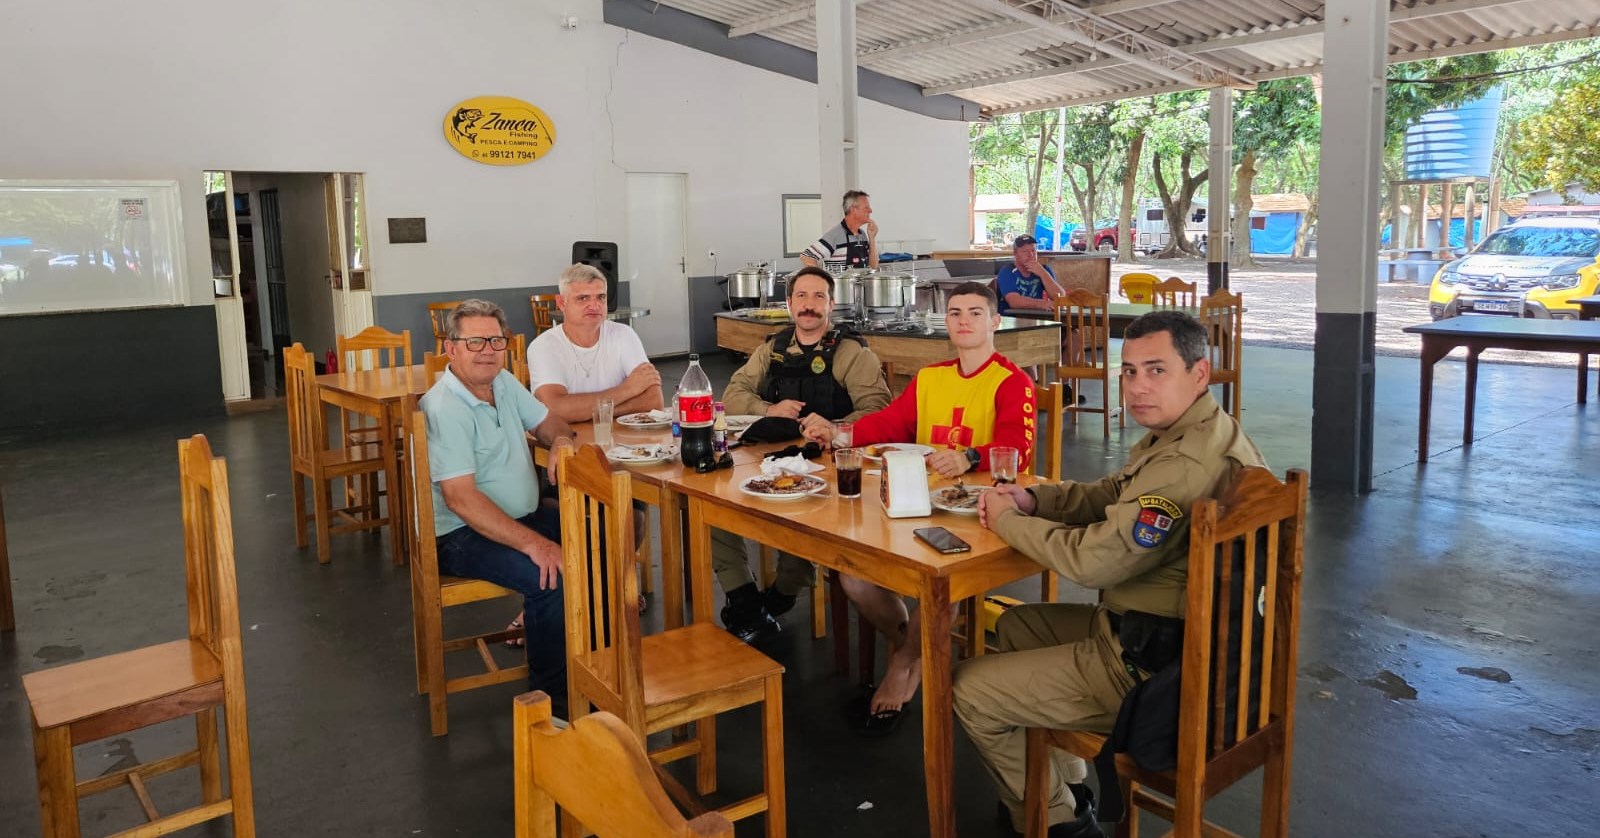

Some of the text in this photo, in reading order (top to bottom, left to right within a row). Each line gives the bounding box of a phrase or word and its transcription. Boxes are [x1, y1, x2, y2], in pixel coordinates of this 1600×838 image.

[480, 112, 537, 131] Zanca
[509, 131, 538, 139] Fishing
[489, 150, 514, 159] 99121
[517, 151, 536, 160] 7941
